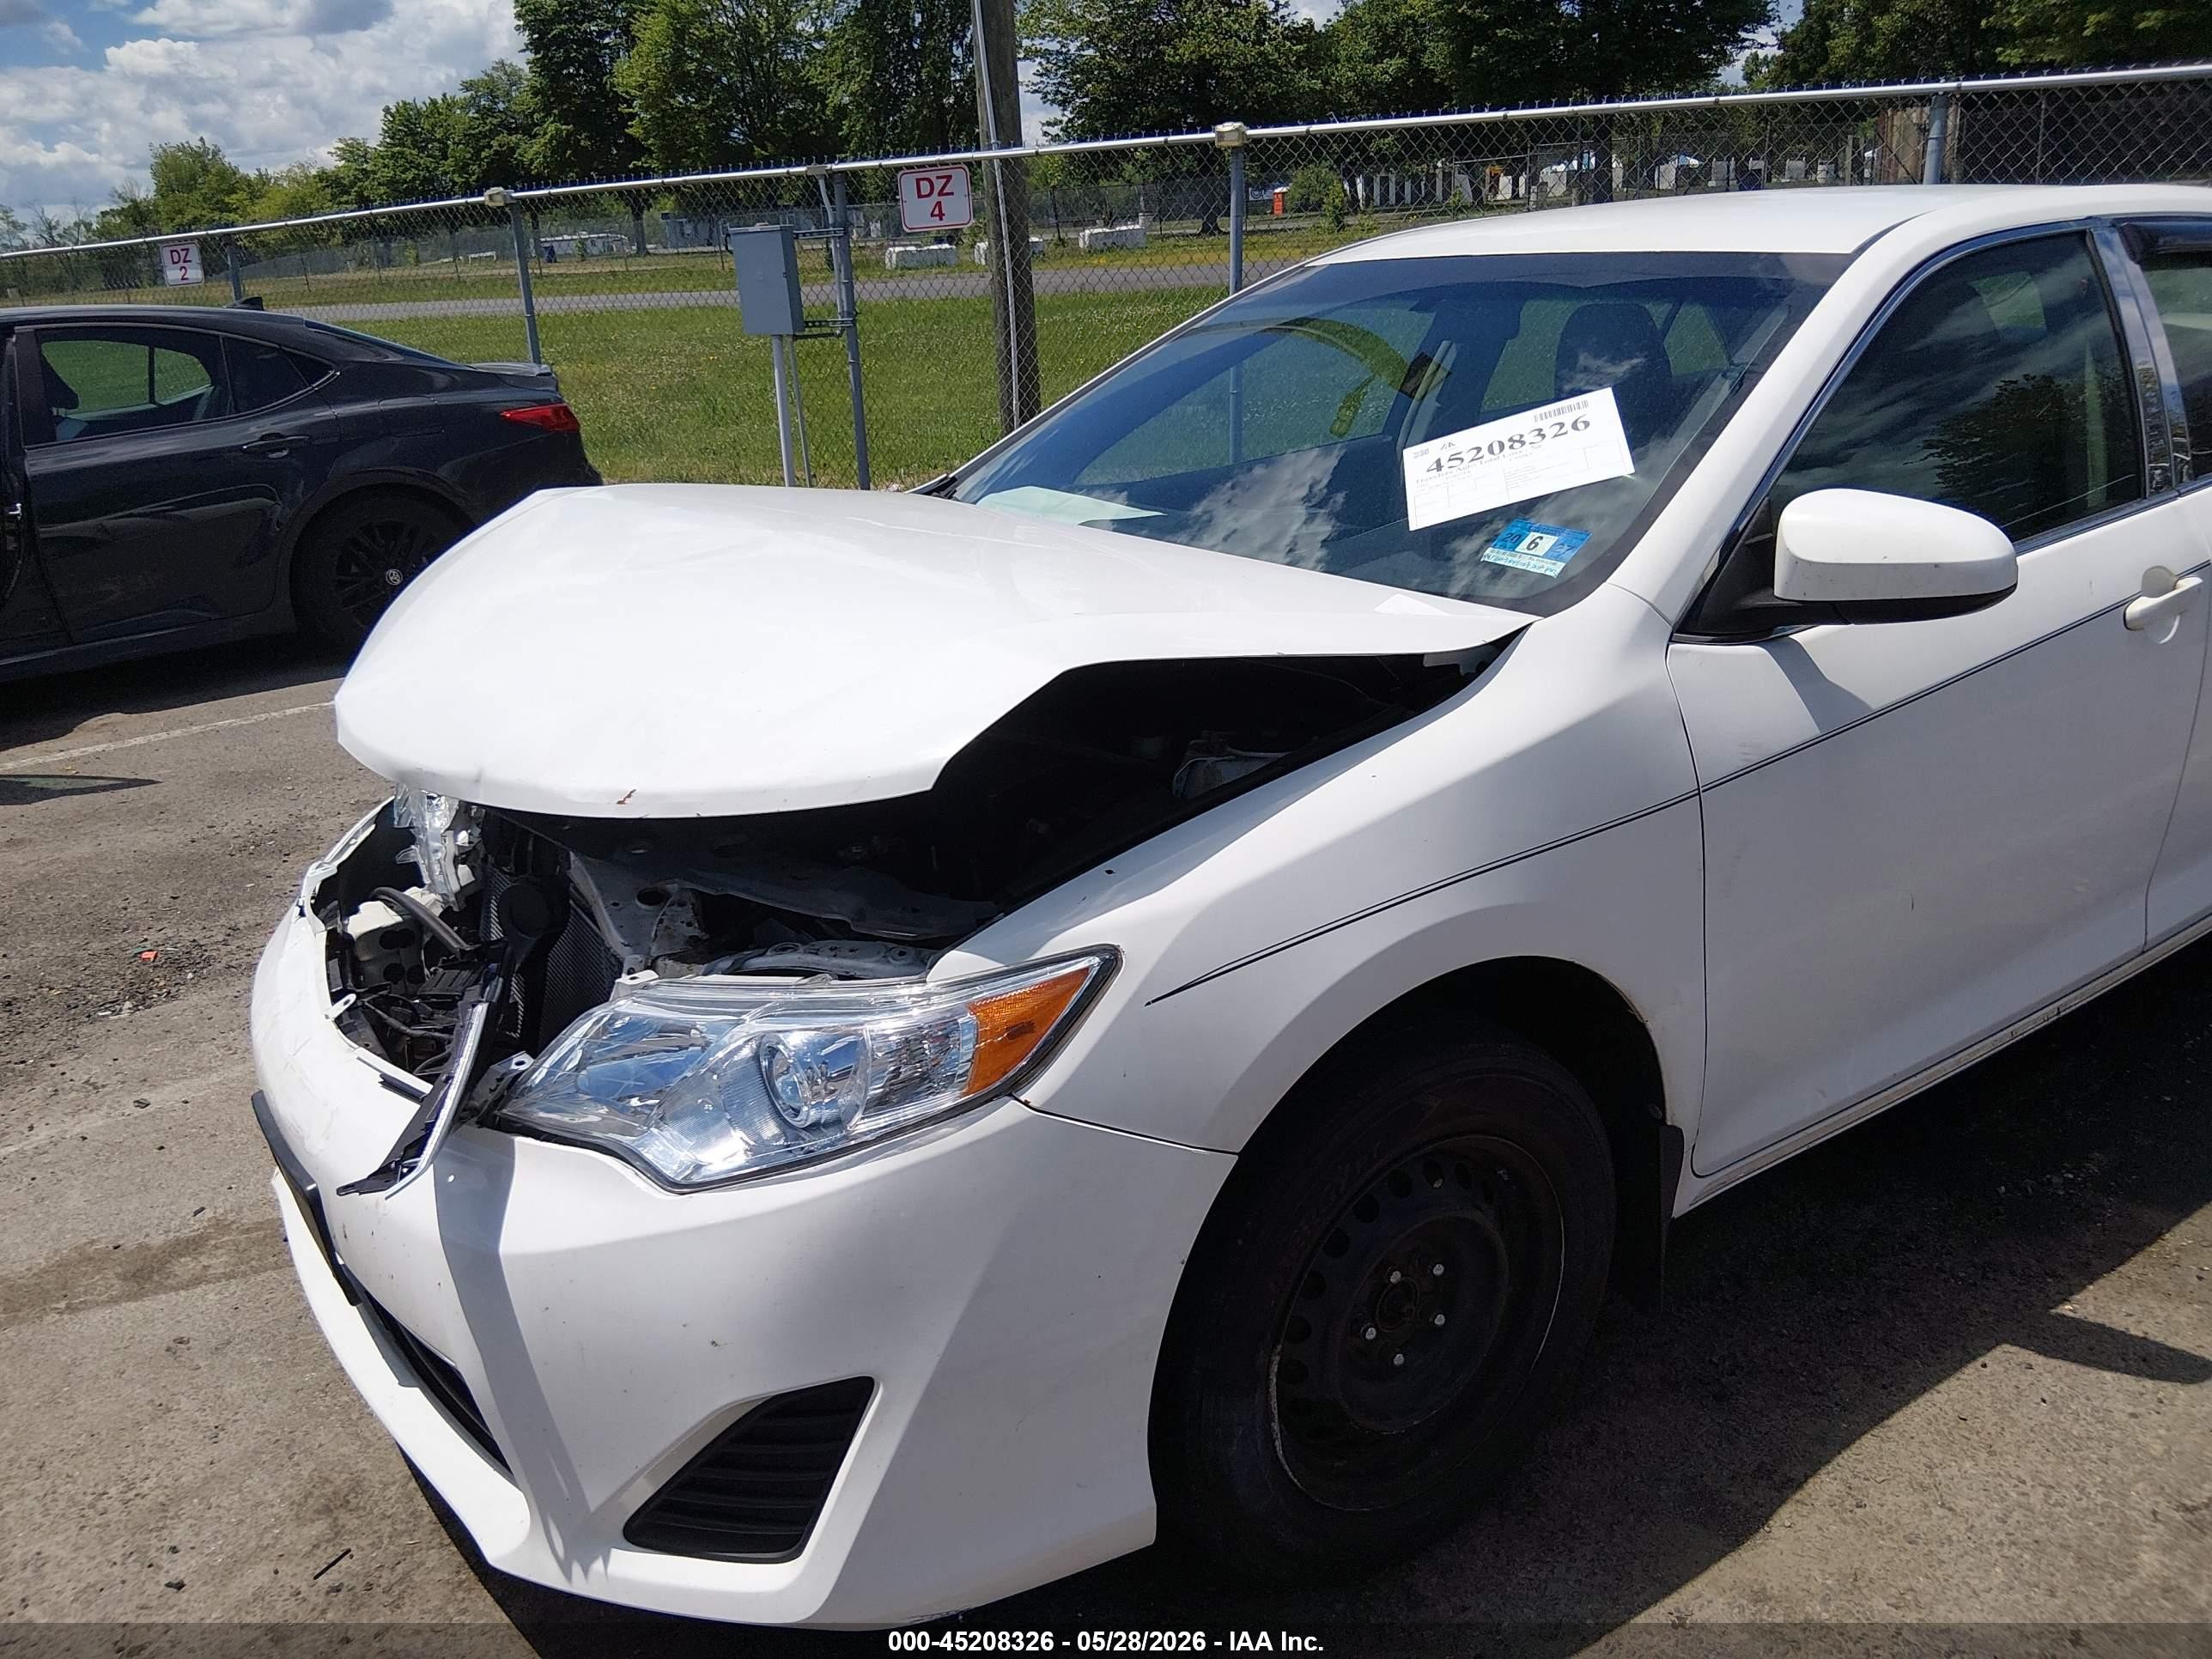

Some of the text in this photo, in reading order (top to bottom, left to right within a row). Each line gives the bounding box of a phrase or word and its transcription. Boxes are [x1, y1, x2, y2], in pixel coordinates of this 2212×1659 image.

[915, 174, 955, 198] DZ
[930, 200, 945, 222] 4
[170, 247, 192, 264] DZ
[179, 265, 190, 281] 2
[1425, 414, 1590, 472] 45208326
[1526, 536, 1544, 551] 6
